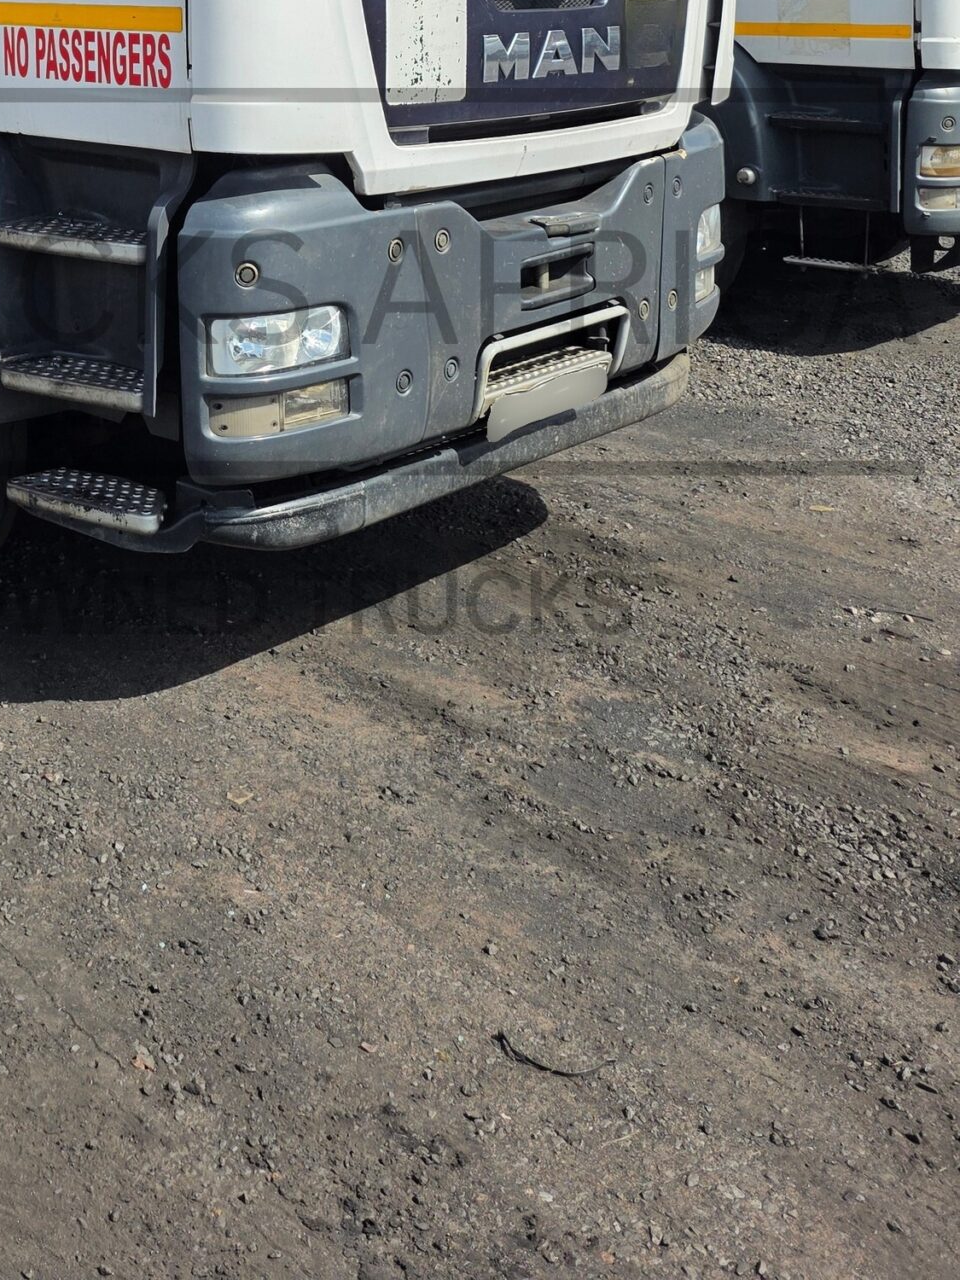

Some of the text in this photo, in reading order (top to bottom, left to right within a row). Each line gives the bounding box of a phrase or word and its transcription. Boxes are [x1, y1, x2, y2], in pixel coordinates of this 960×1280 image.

[4, 27, 172, 90] NO PASSENGERS
[482, 26, 621, 84] MAN
